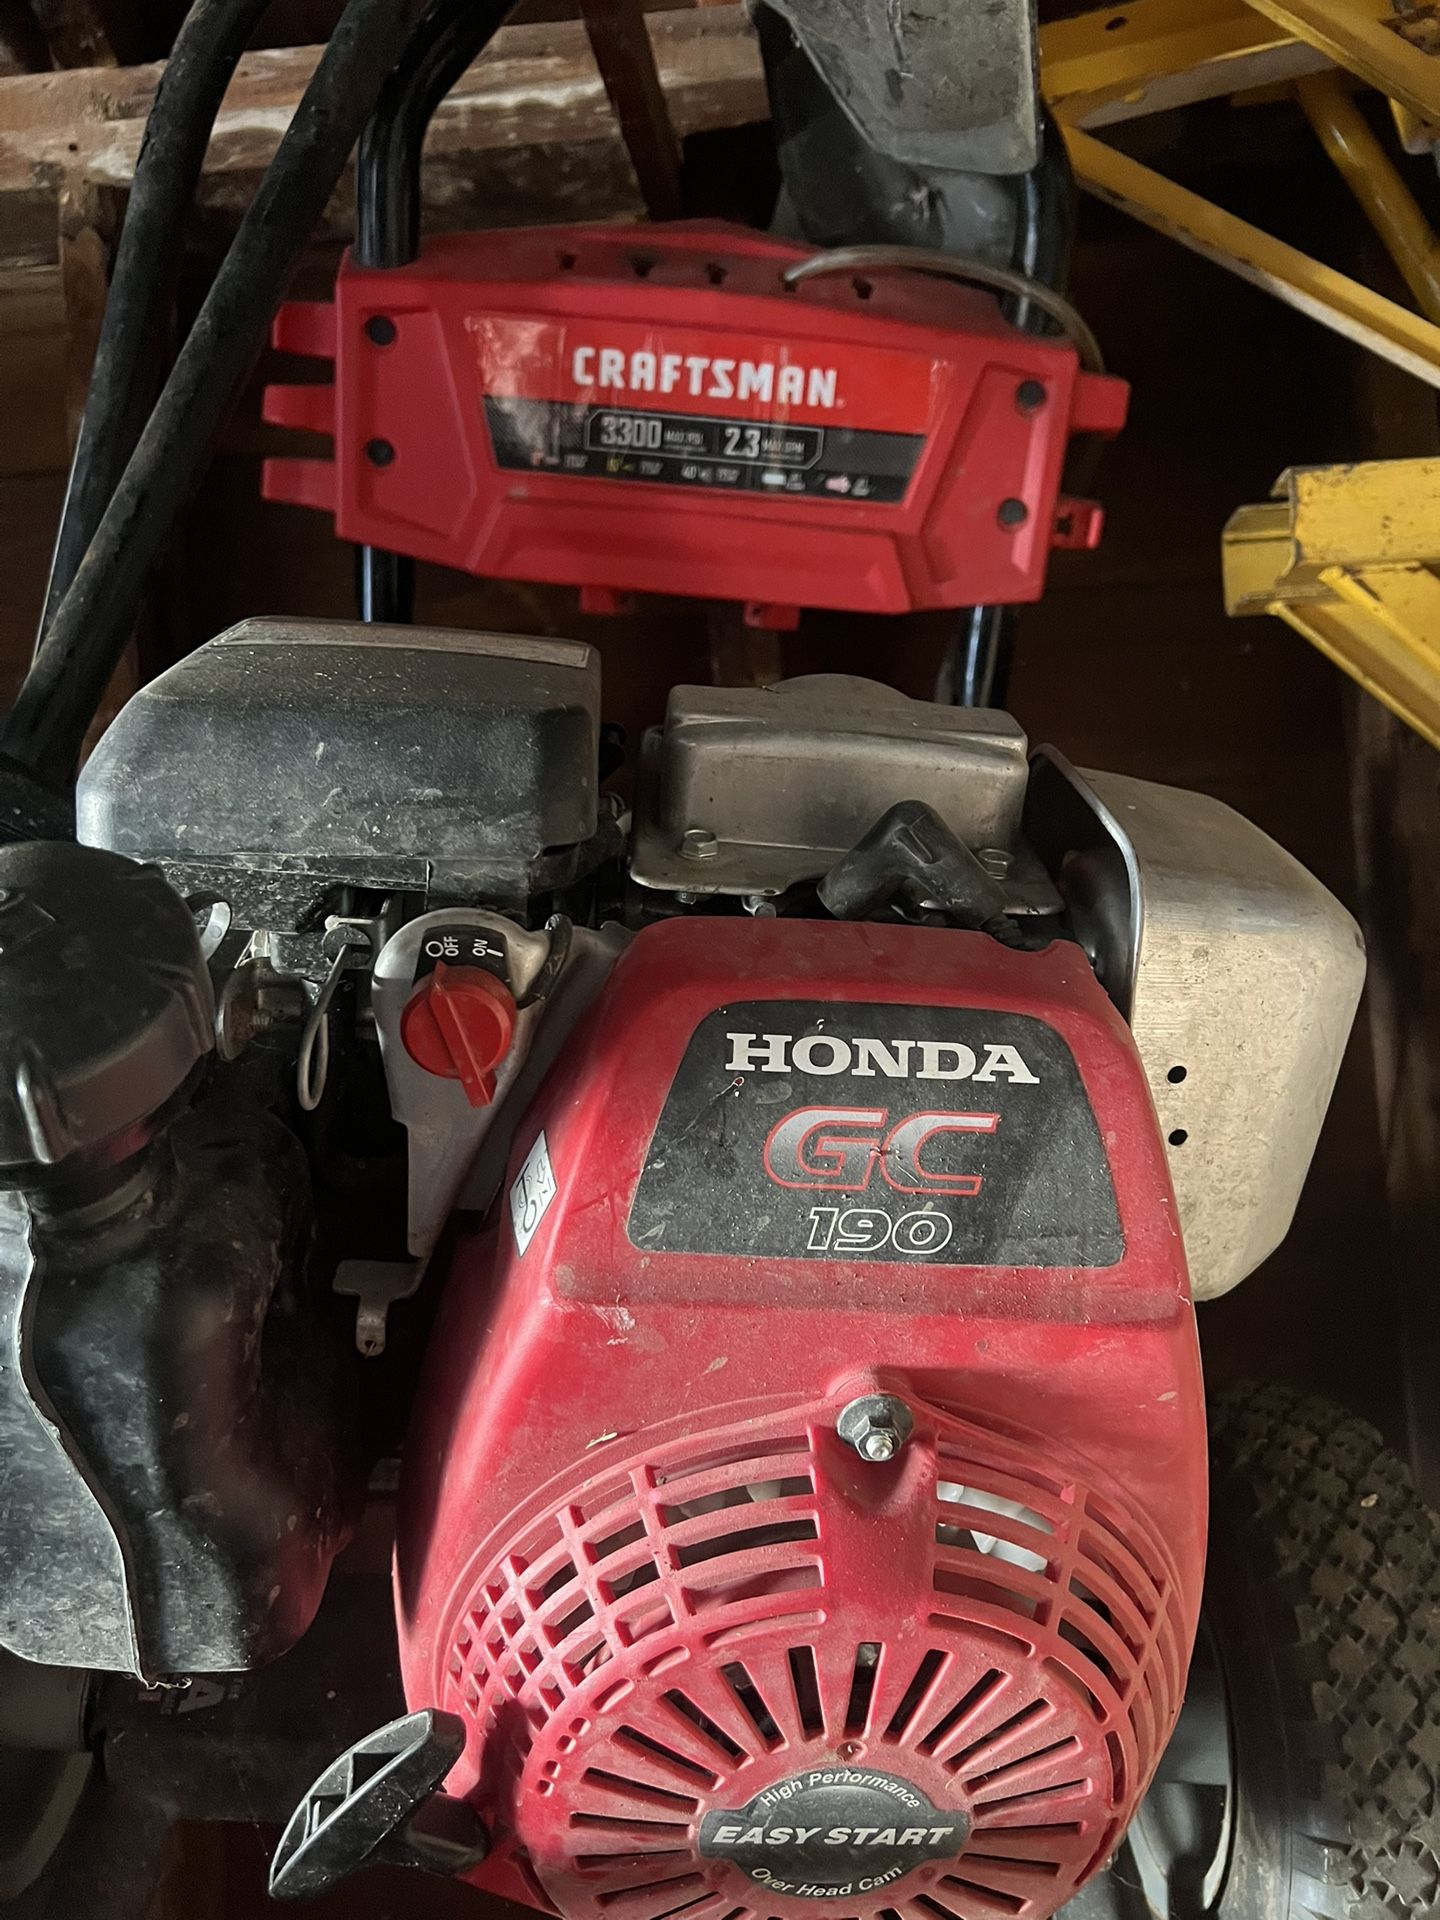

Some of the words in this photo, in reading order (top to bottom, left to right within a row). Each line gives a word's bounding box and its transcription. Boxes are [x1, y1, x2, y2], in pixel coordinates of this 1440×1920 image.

[572, 346, 838, 408] CRAFTSMAN
[601, 416, 662, 449] 3300
[443, 936, 460, 957] OFF
[472, 938, 489, 957] ON
[725, 1032, 1041, 1085] HONDA
[763, 1105, 1001, 1197] GC
[806, 1206, 953, 1254] 190
[760, 1780, 803, 1808] High
[809, 1770, 921, 1808] Performance
[712, 1826, 821, 1845] EASY
[824, 1826, 954, 1846] START
[751, 1867, 795, 1892] Over
[797, 1883, 853, 1898] Head
[858, 1865, 903, 1890] Cam
